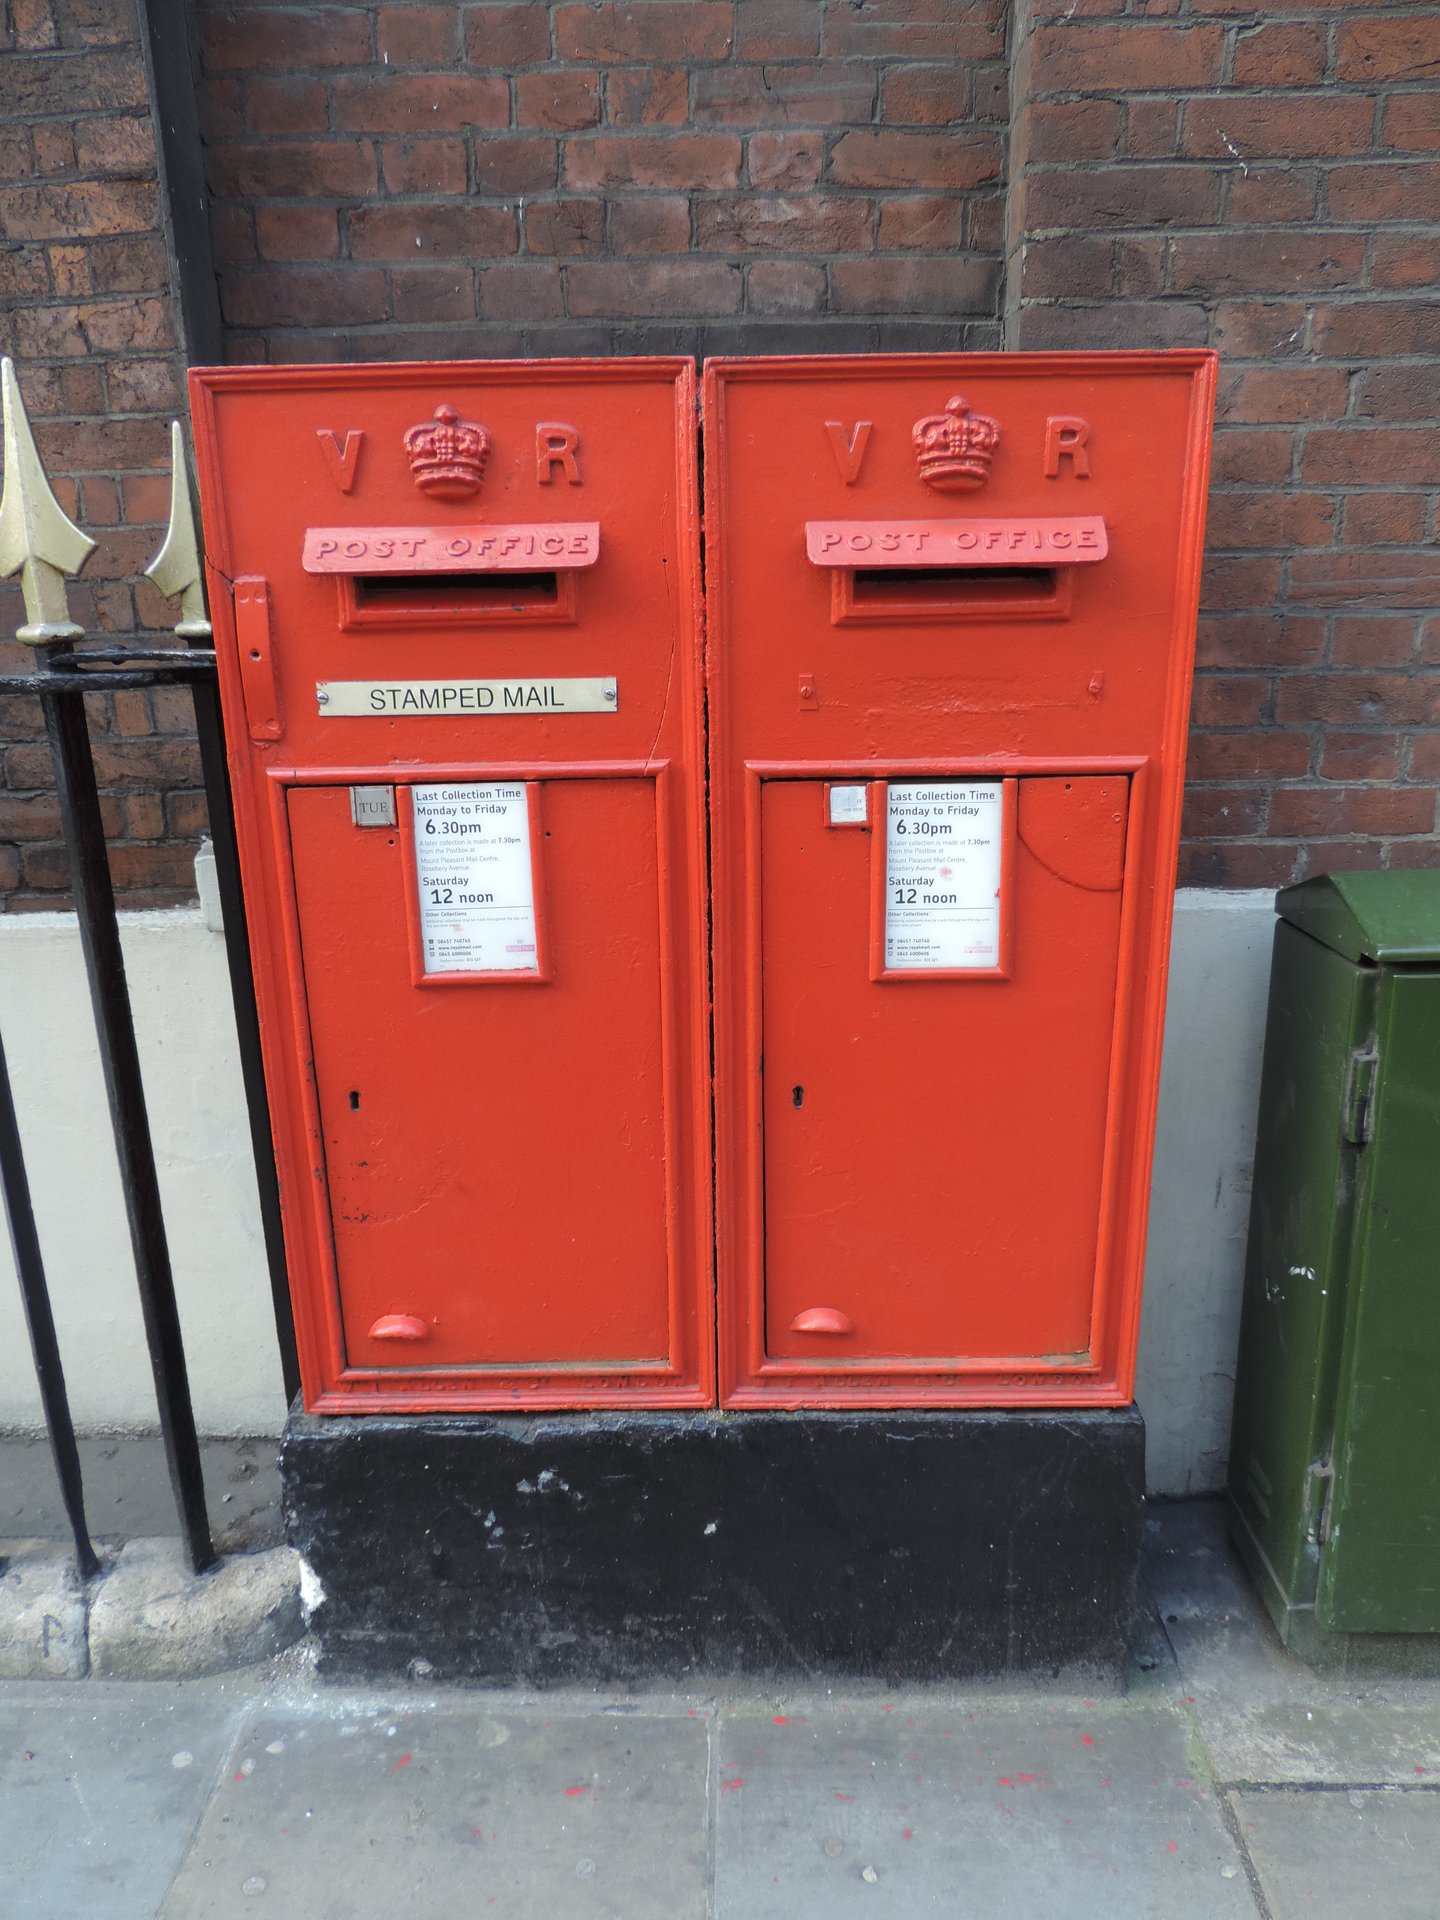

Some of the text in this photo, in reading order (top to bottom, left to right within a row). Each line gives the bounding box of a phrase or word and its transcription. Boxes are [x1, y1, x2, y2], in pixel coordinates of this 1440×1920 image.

[824, 416, 1092, 487] V R
[316, 422, 583, 496] V R
[316, 534, 589, 560] POST OFFICE
[820, 528, 1098, 553] POST OFFICE
[370, 686, 565, 710] STAMPED MAIL
[416, 789, 521, 801] Last Collection Time
[890, 791, 995, 801] Last Collection Time
[417, 804, 507, 816] Monday to Friday
[890, 806, 979, 817] Monday to Friday
[425, 819, 482, 836] 6.30pm
[896, 819, 952, 836] 6.30pm
[422, 865, 447, 873] Rosebery
[423, 876, 469, 886] Saturday
[889, 876, 934, 886] Saturday
[430, 888, 494, 904] 12 noon
[895, 888, 957, 904] 12 noon
[584, 1375, 687, 1388] LONDON
[998, 1374, 1099, 1386] LONDON
